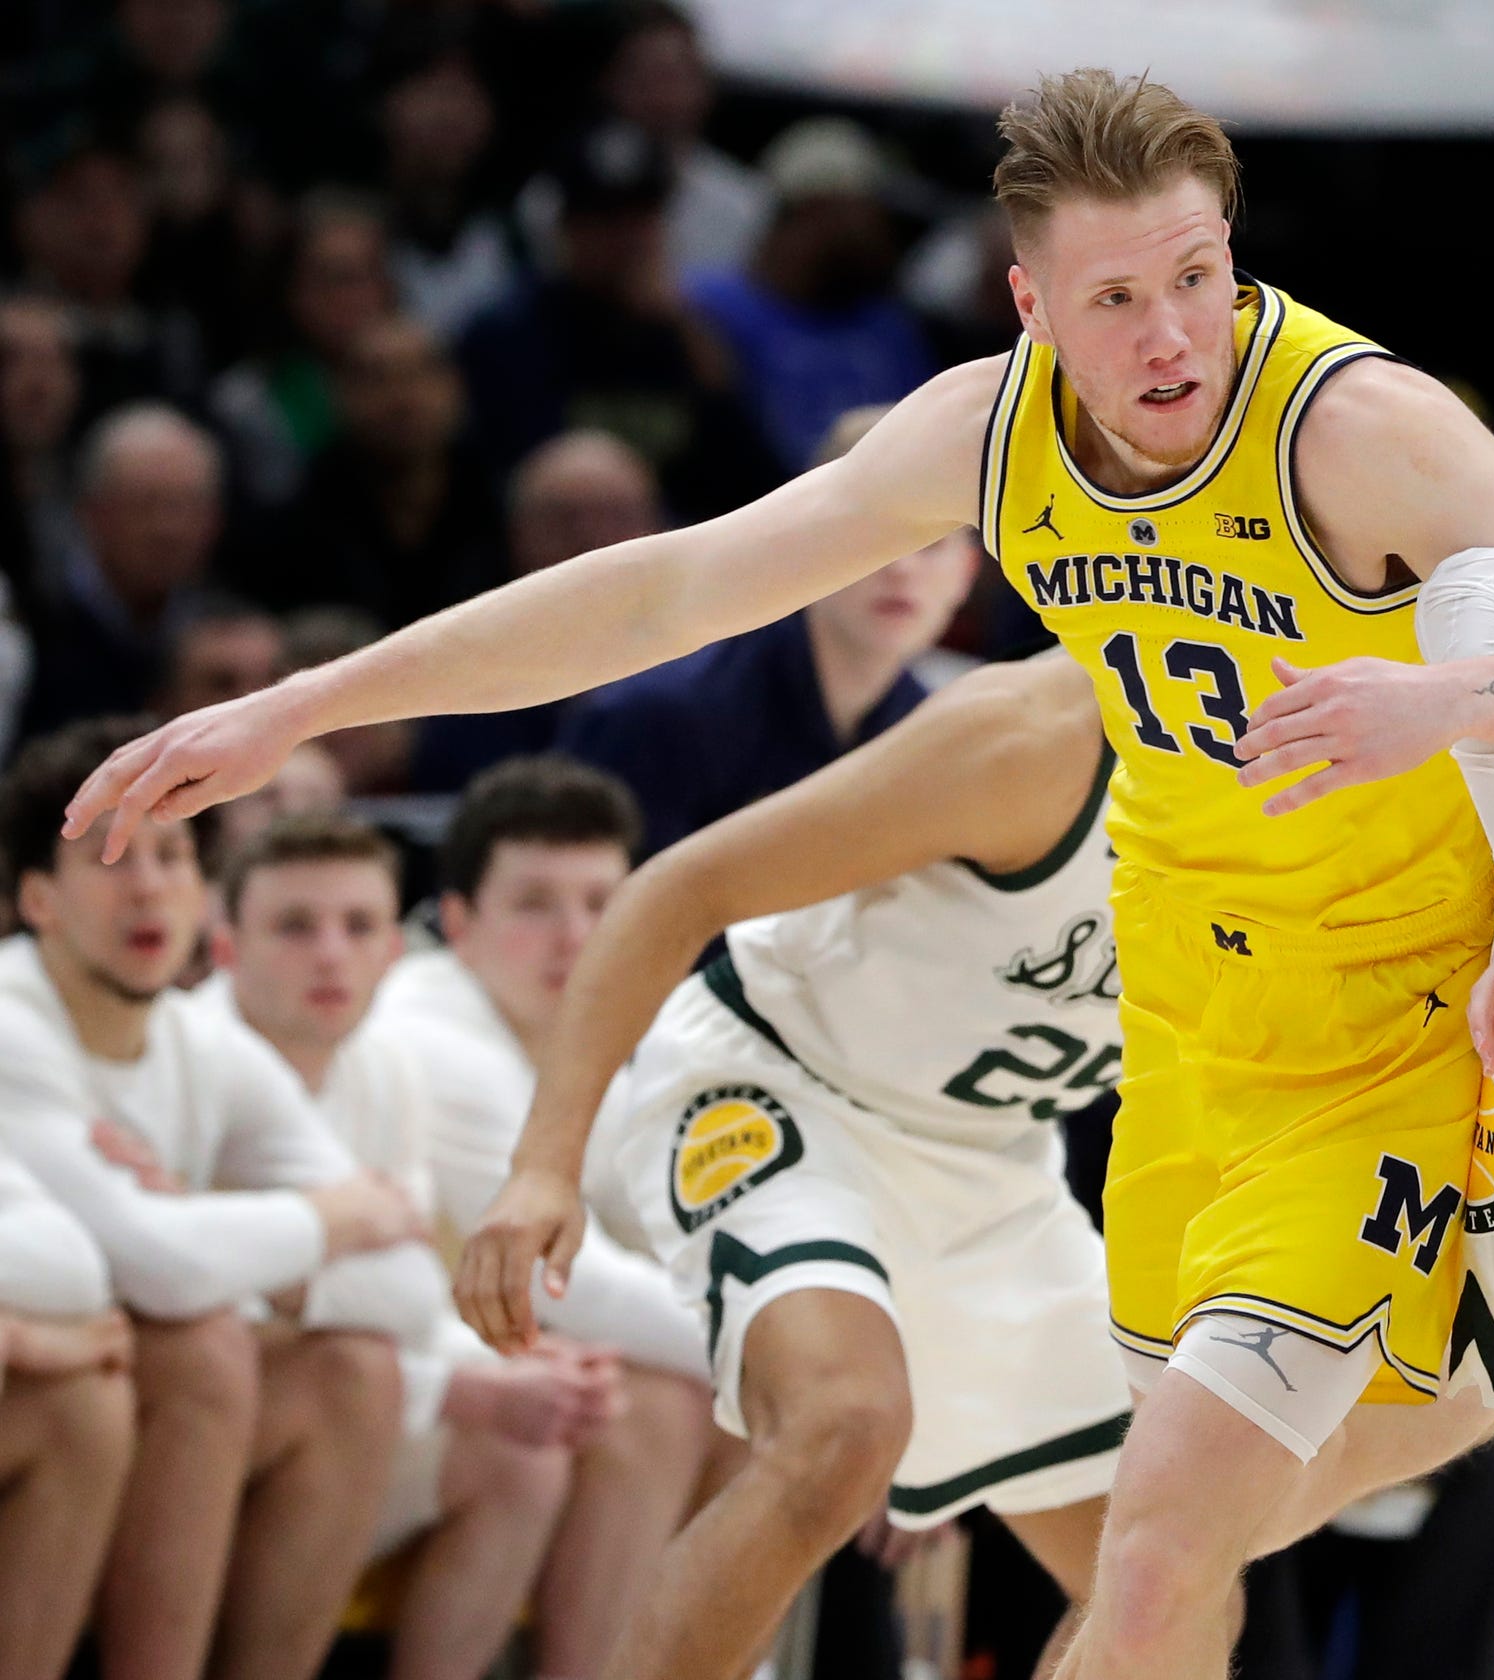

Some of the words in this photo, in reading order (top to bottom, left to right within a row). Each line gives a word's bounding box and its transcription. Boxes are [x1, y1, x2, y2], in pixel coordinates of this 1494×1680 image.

[1132, 524, 1156, 541] M
[1025, 553, 1307, 642] MICHIGAN
[1100, 630, 1262, 771] 13
[1211, 922, 1252, 957] M
[1358, 1151, 1463, 1279] M
